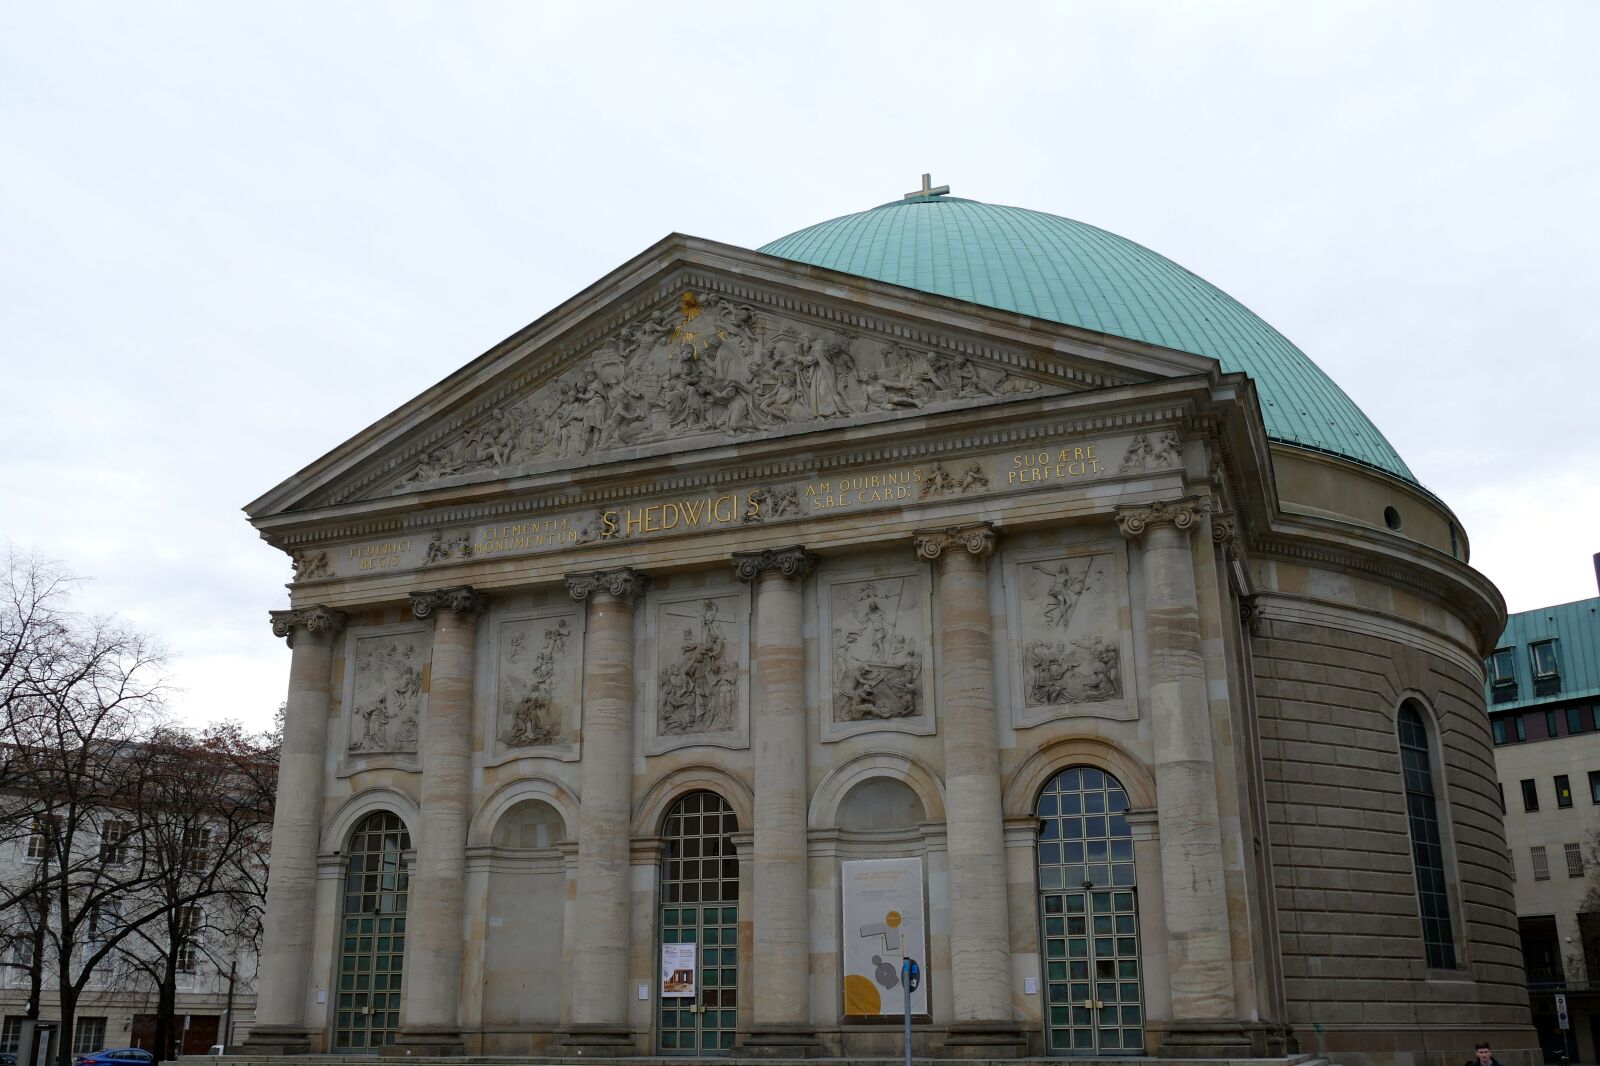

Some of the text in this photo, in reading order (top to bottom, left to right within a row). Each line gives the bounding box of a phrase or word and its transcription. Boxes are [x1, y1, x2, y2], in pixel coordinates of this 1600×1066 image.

[1014, 445, 1096, 469] SUO ÆRE
[840, 469, 921, 492] QUIRINUS
[1008, 460, 1105, 484] PERFECIT.
[484, 518, 570, 541] CLEMENTIÆ
[602, 511, 617, 536] S
[474, 531, 577, 555] MONUMENTUM
[360, 556, 400, 571] REGIS
